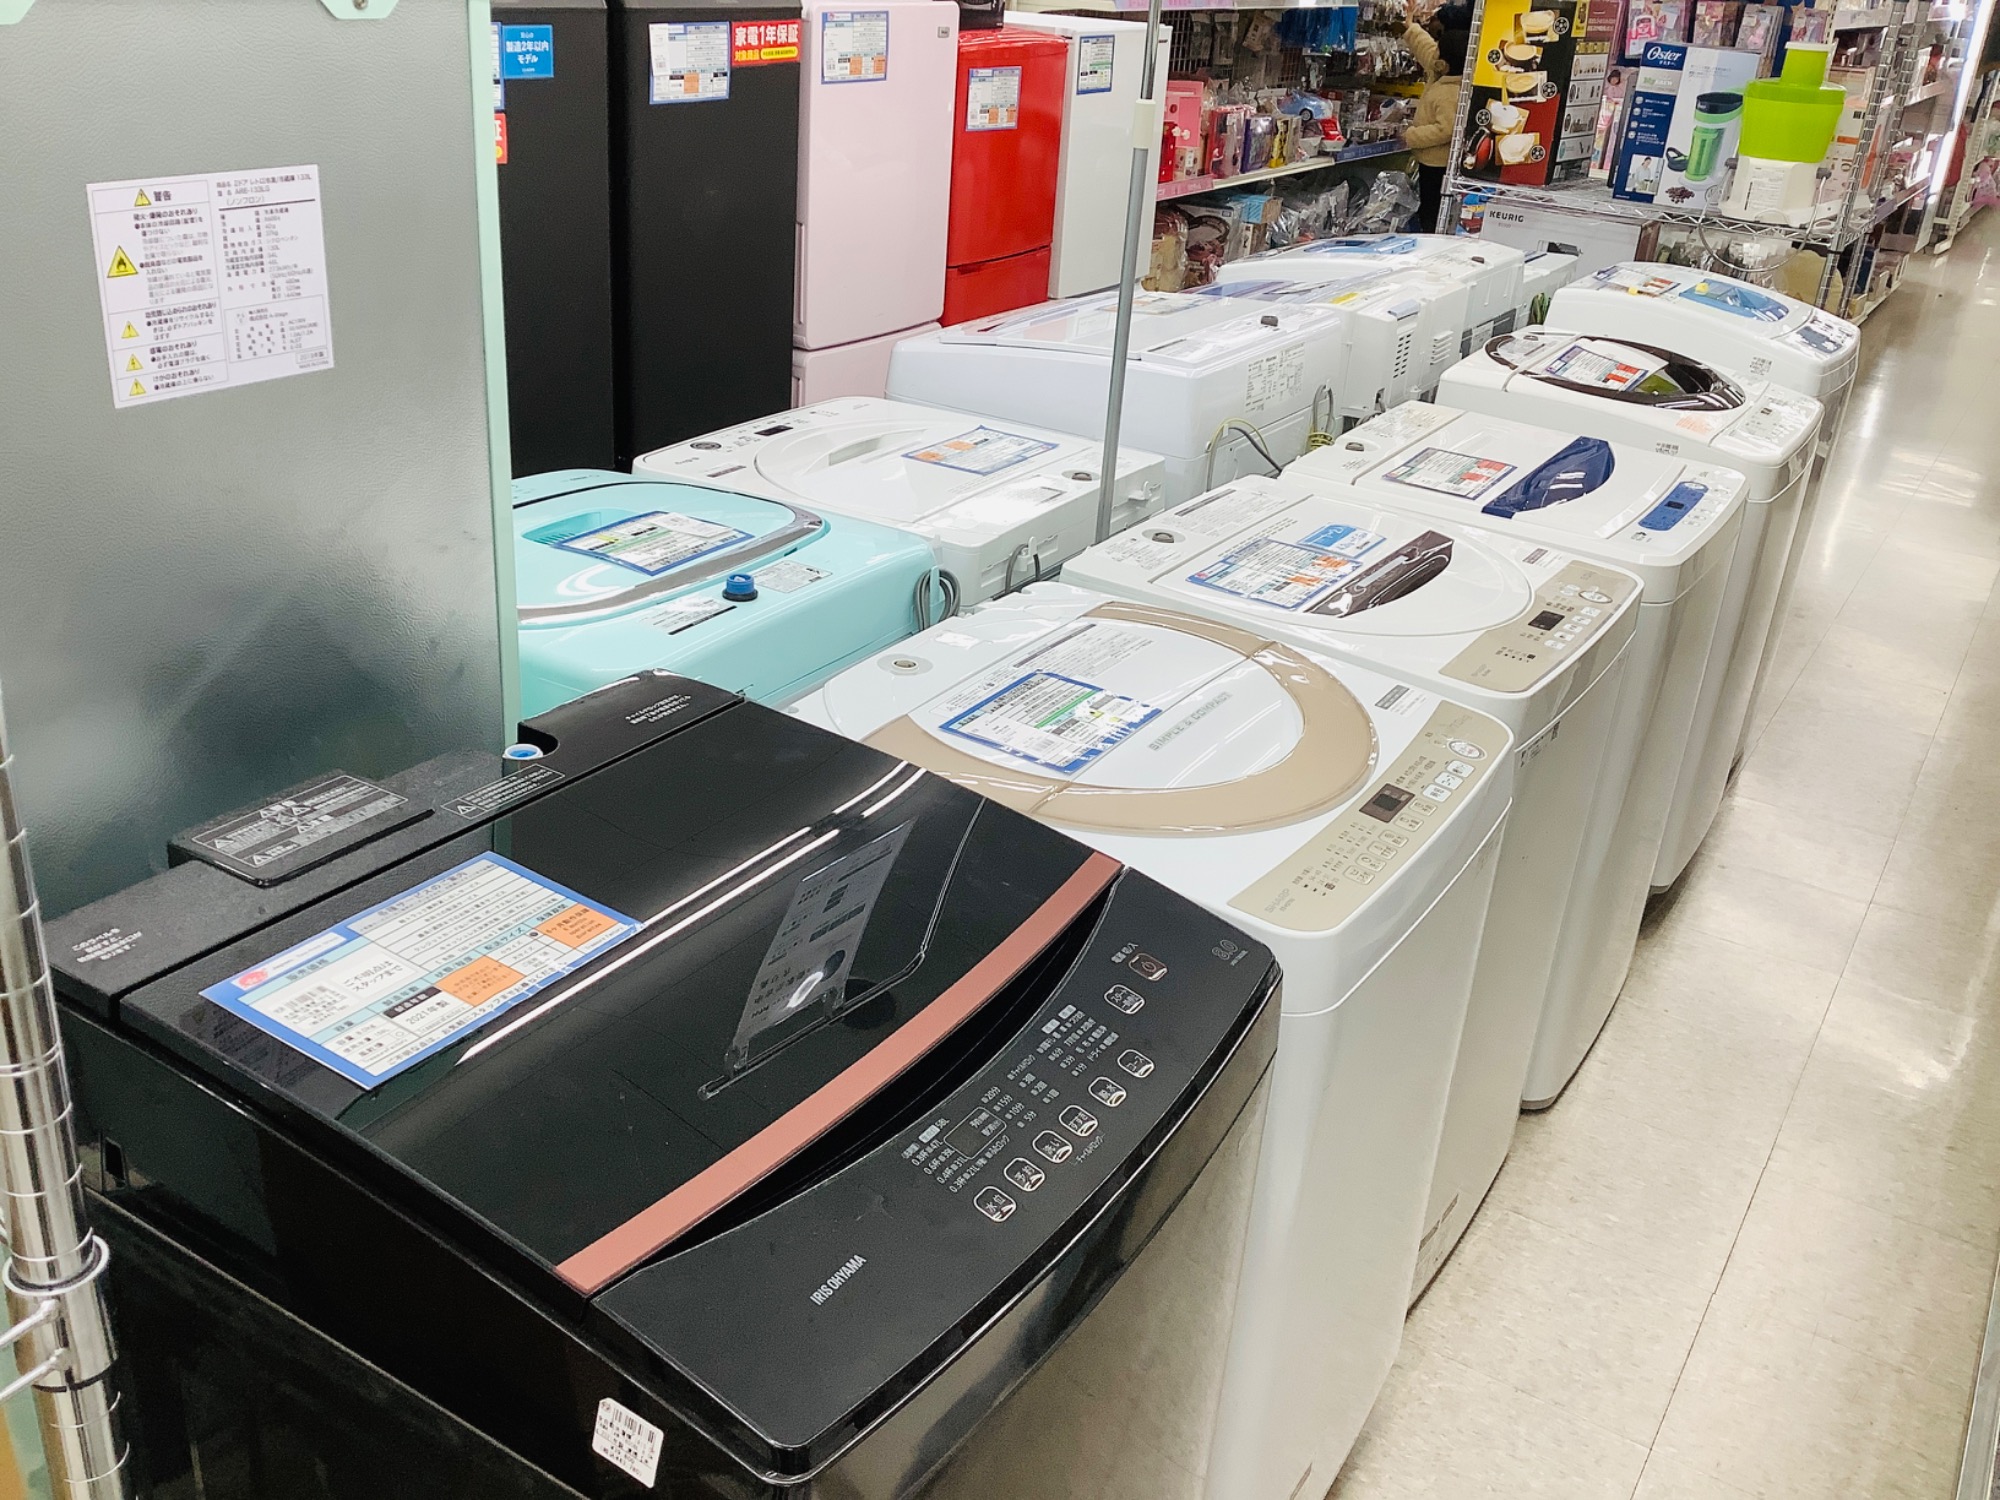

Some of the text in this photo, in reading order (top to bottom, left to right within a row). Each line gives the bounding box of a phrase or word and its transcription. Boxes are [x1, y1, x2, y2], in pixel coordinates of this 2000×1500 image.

[735, 24, 799, 47] 家電1年保証
[505, 40, 549, 53] 製造2年以内
[1646, 45, 1682, 61] Oster
[517, 53, 539, 64] モデル
[1489, 210, 1525, 223] KEURIG
[1149, 723, 1188, 752] SIMPLE
[1191, 691, 1232, 724] COMPACT
[1211, 939, 1238, 960] 8.0
[341, 959, 392, 987] ご不明点は
[352, 964, 403, 992] スタッフまで
[405, 999, 450, 1024] 2021年製
[1126, 1055, 1145, 1071] コース
[984, 1084, 1001, 1100] 20分
[1098, 1083, 1117, 1099] 脱水
[997, 1093, 1013, 1108] 15分
[1009, 1101, 1025, 1116] 10分
[1022, 1109, 1037, 1122] 5分
[1068, 1111, 1089, 1130] すすぎ
[1043, 1137, 1063, 1155] 洗い
[923, 1158, 942, 1175] 0.6杯
[1014, 1164, 1036, 1183] 予約
[936, 1167, 955, 1184] 0.4杯
[949, 1177, 967, 1193] 0.3杯
[985, 1194, 1006, 1213] 水位
[809, 1254, 868, 1306] IRIS OHYAMA
